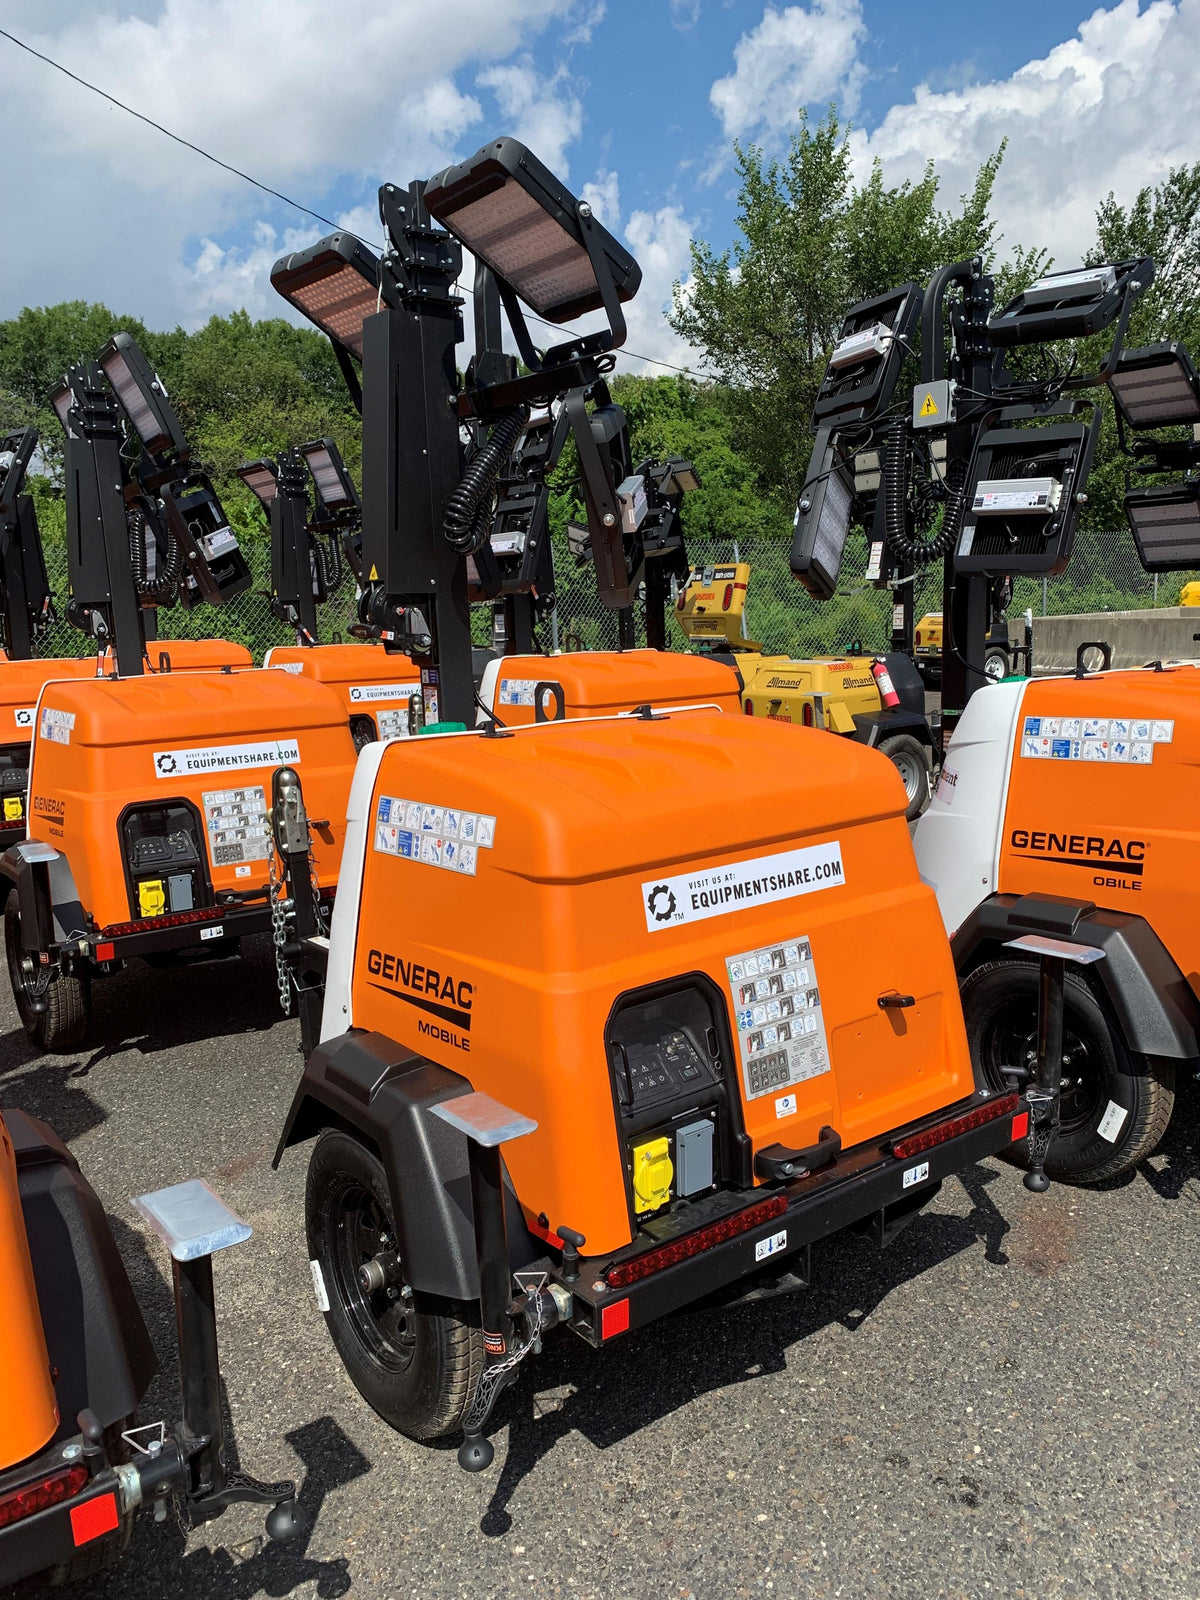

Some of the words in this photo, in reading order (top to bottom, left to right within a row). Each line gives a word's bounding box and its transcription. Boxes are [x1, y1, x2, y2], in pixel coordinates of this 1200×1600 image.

[767, 677, 802, 688] Allmand
[842, 675, 874, 689] Allmand
[187, 750, 298, 769] EQUIPMENTSHARE.COM
[34, 796, 65, 815] GENERAC
[1011, 830, 1145, 860] GENERAC
[689, 879, 709, 890] VISIT
[712, 876, 722, 884] US
[724, 873, 736, 882] AT:
[691, 861, 842, 910] EQUIPMENTSHARE.COM
[368, 949, 473, 1010] GENERAC
[418, 1019, 471, 1052] MOBILE
